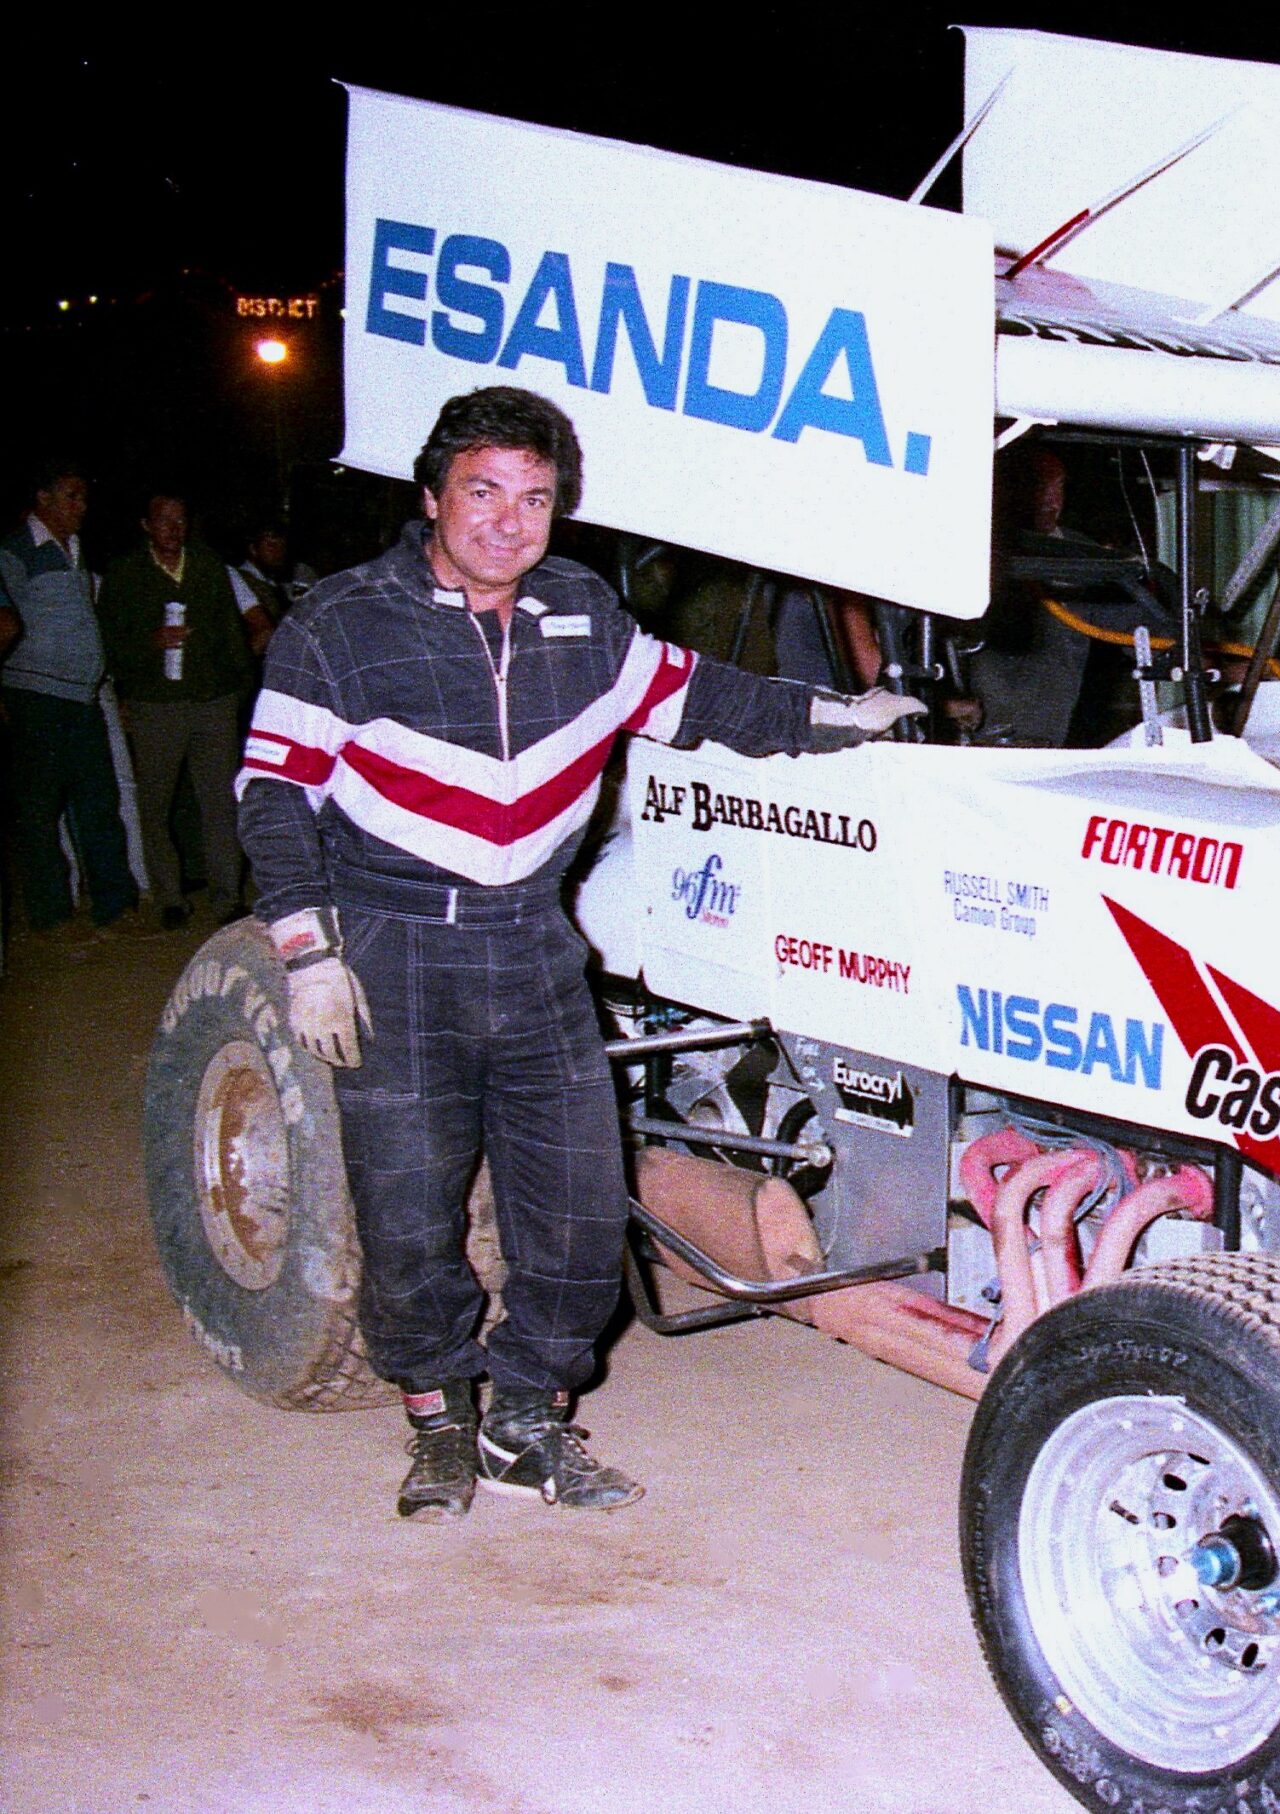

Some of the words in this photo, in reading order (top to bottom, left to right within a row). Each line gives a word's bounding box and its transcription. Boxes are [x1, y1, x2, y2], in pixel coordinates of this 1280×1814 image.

[641, 775, 687, 823] ALF
[690, 782, 878, 852] BARBAGALLO
[1082, 815, 1244, 889] FORTRON
[944, 869, 1002, 903] RUSSELL
[1006, 881, 1050, 912] SMITH
[1000, 906, 1036, 941] Group
[775, 935, 833, 973] GEOFF
[838, 949, 912, 994] MURPHY
[956, 984, 1165, 1091] NISSAN
[832, 1056, 903, 1104] Eurocryl
